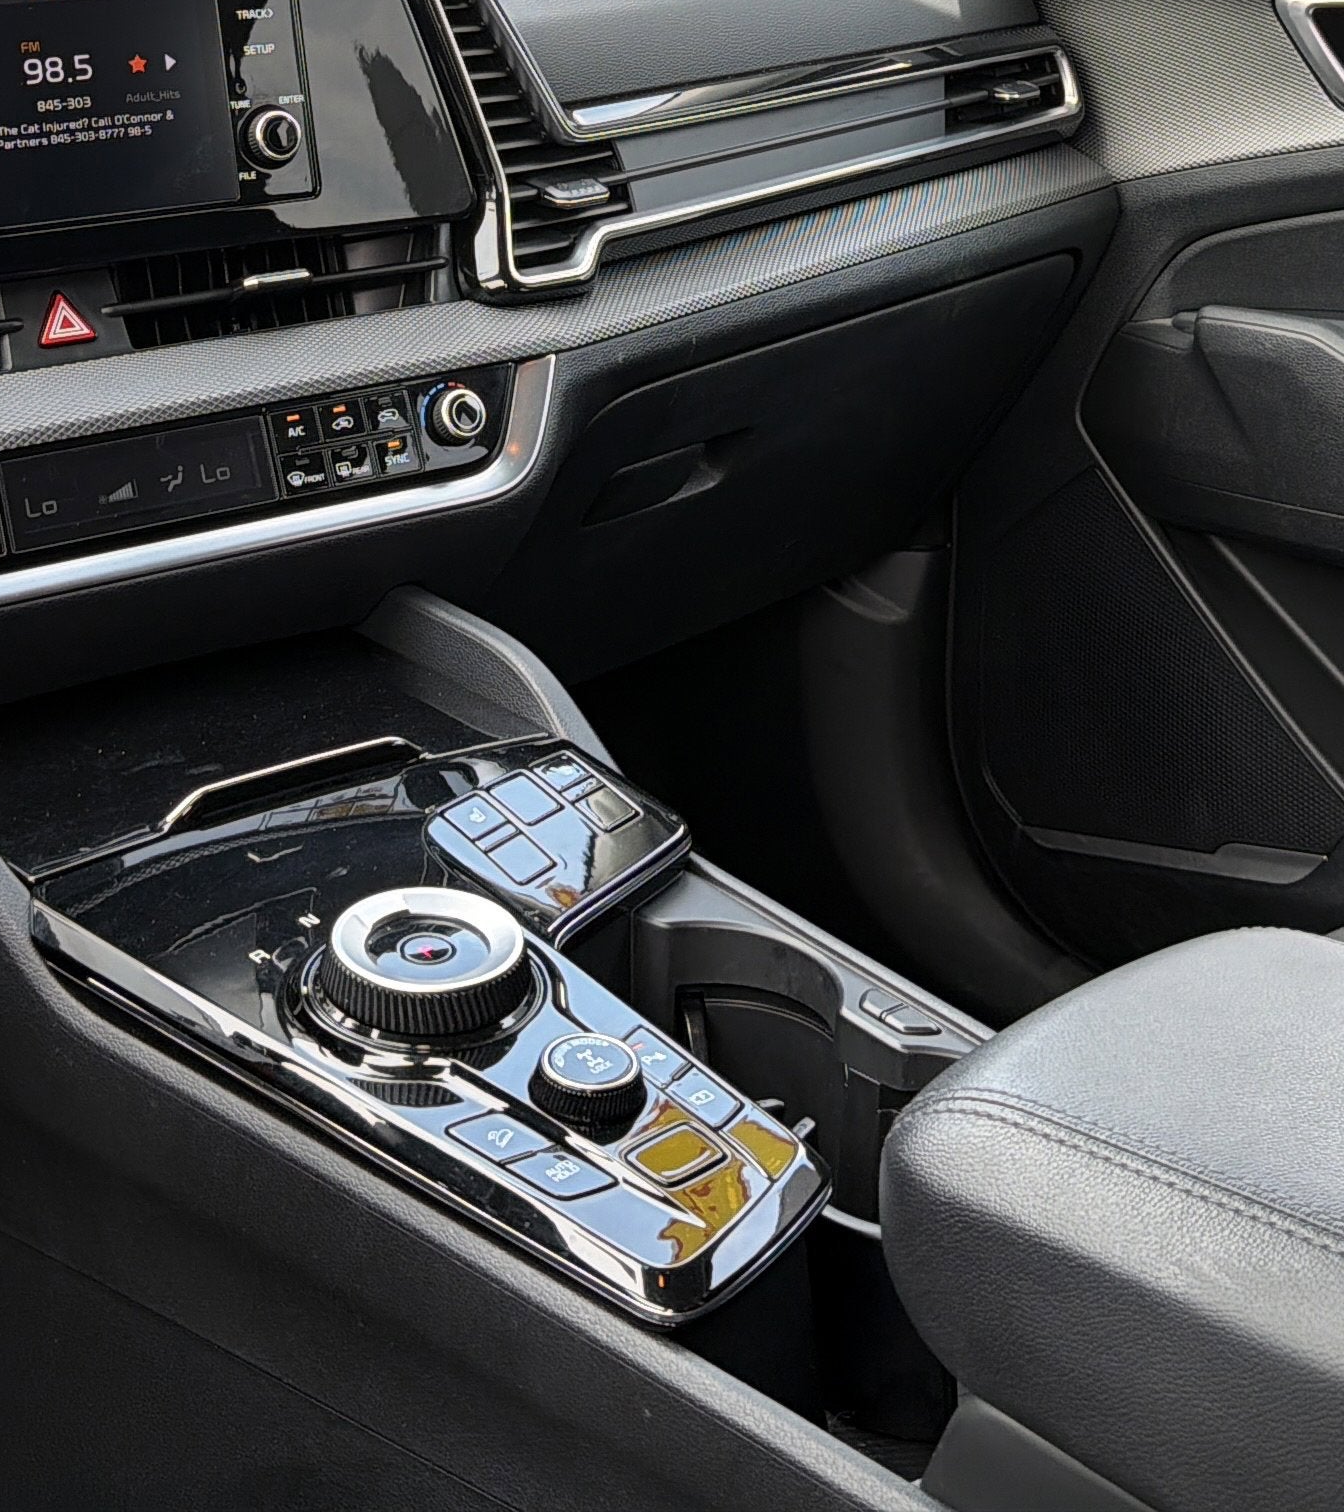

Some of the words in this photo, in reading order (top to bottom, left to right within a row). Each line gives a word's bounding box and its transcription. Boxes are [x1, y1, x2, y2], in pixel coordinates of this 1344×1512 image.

[20, 41, 40, 53] FM
[243, 43, 275, 56] SETUP
[23, 53, 93, 86] 98.5
[37, 97, 92, 112] 845-303
[230, 99, 251, 110] TUNE
[279, 94, 305, 105] ENTER
[20, 123, 40, 136] Cat
[42, 117, 89, 135] Injured?
[91, 116, 113, 129] Call
[114, 111, 163, 126] O'Connor
[166, 109, 175, 121] &
[50, 128, 125, 145] 845-303-8777
[127, 125, 153, 137] 98-5
[239, 171, 257, 182] FILE
[288, 425, 306, 438] A/C
[384, 453, 411, 467] SYNC
[201, 464, 232, 486] Lo
[304, 472, 325, 484] FRONT
[26, 495, 57, 520] Lo
[298, 912, 321, 928] N
[248, 949, 271, 965] R
[545, 1159, 574, 1177] AUTO
[551, 1165, 581, 1183] HOLD
